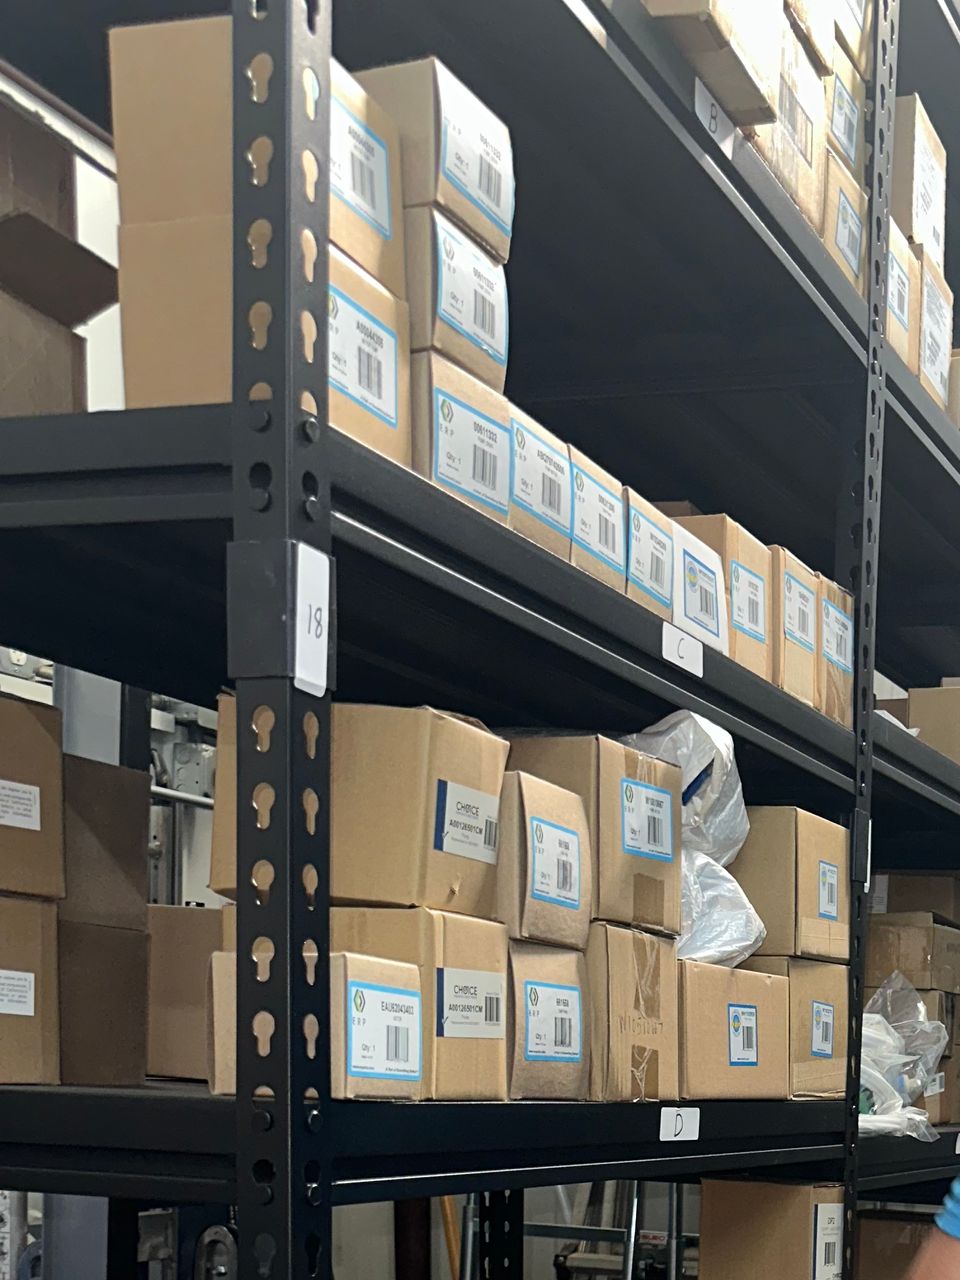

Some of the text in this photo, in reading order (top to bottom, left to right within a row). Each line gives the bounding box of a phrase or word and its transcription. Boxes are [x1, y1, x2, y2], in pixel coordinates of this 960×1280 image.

[709, 103, 718, 134] B
[308, 604, 323, 639] 18
[677, 638, 685, 659] C
[456, 801, 480, 817] CHOICE
[454, 984, 478, 996] CHOICE
[352, 1016, 367, 1027] ERP
[673, 1113, 684, 1138] D
